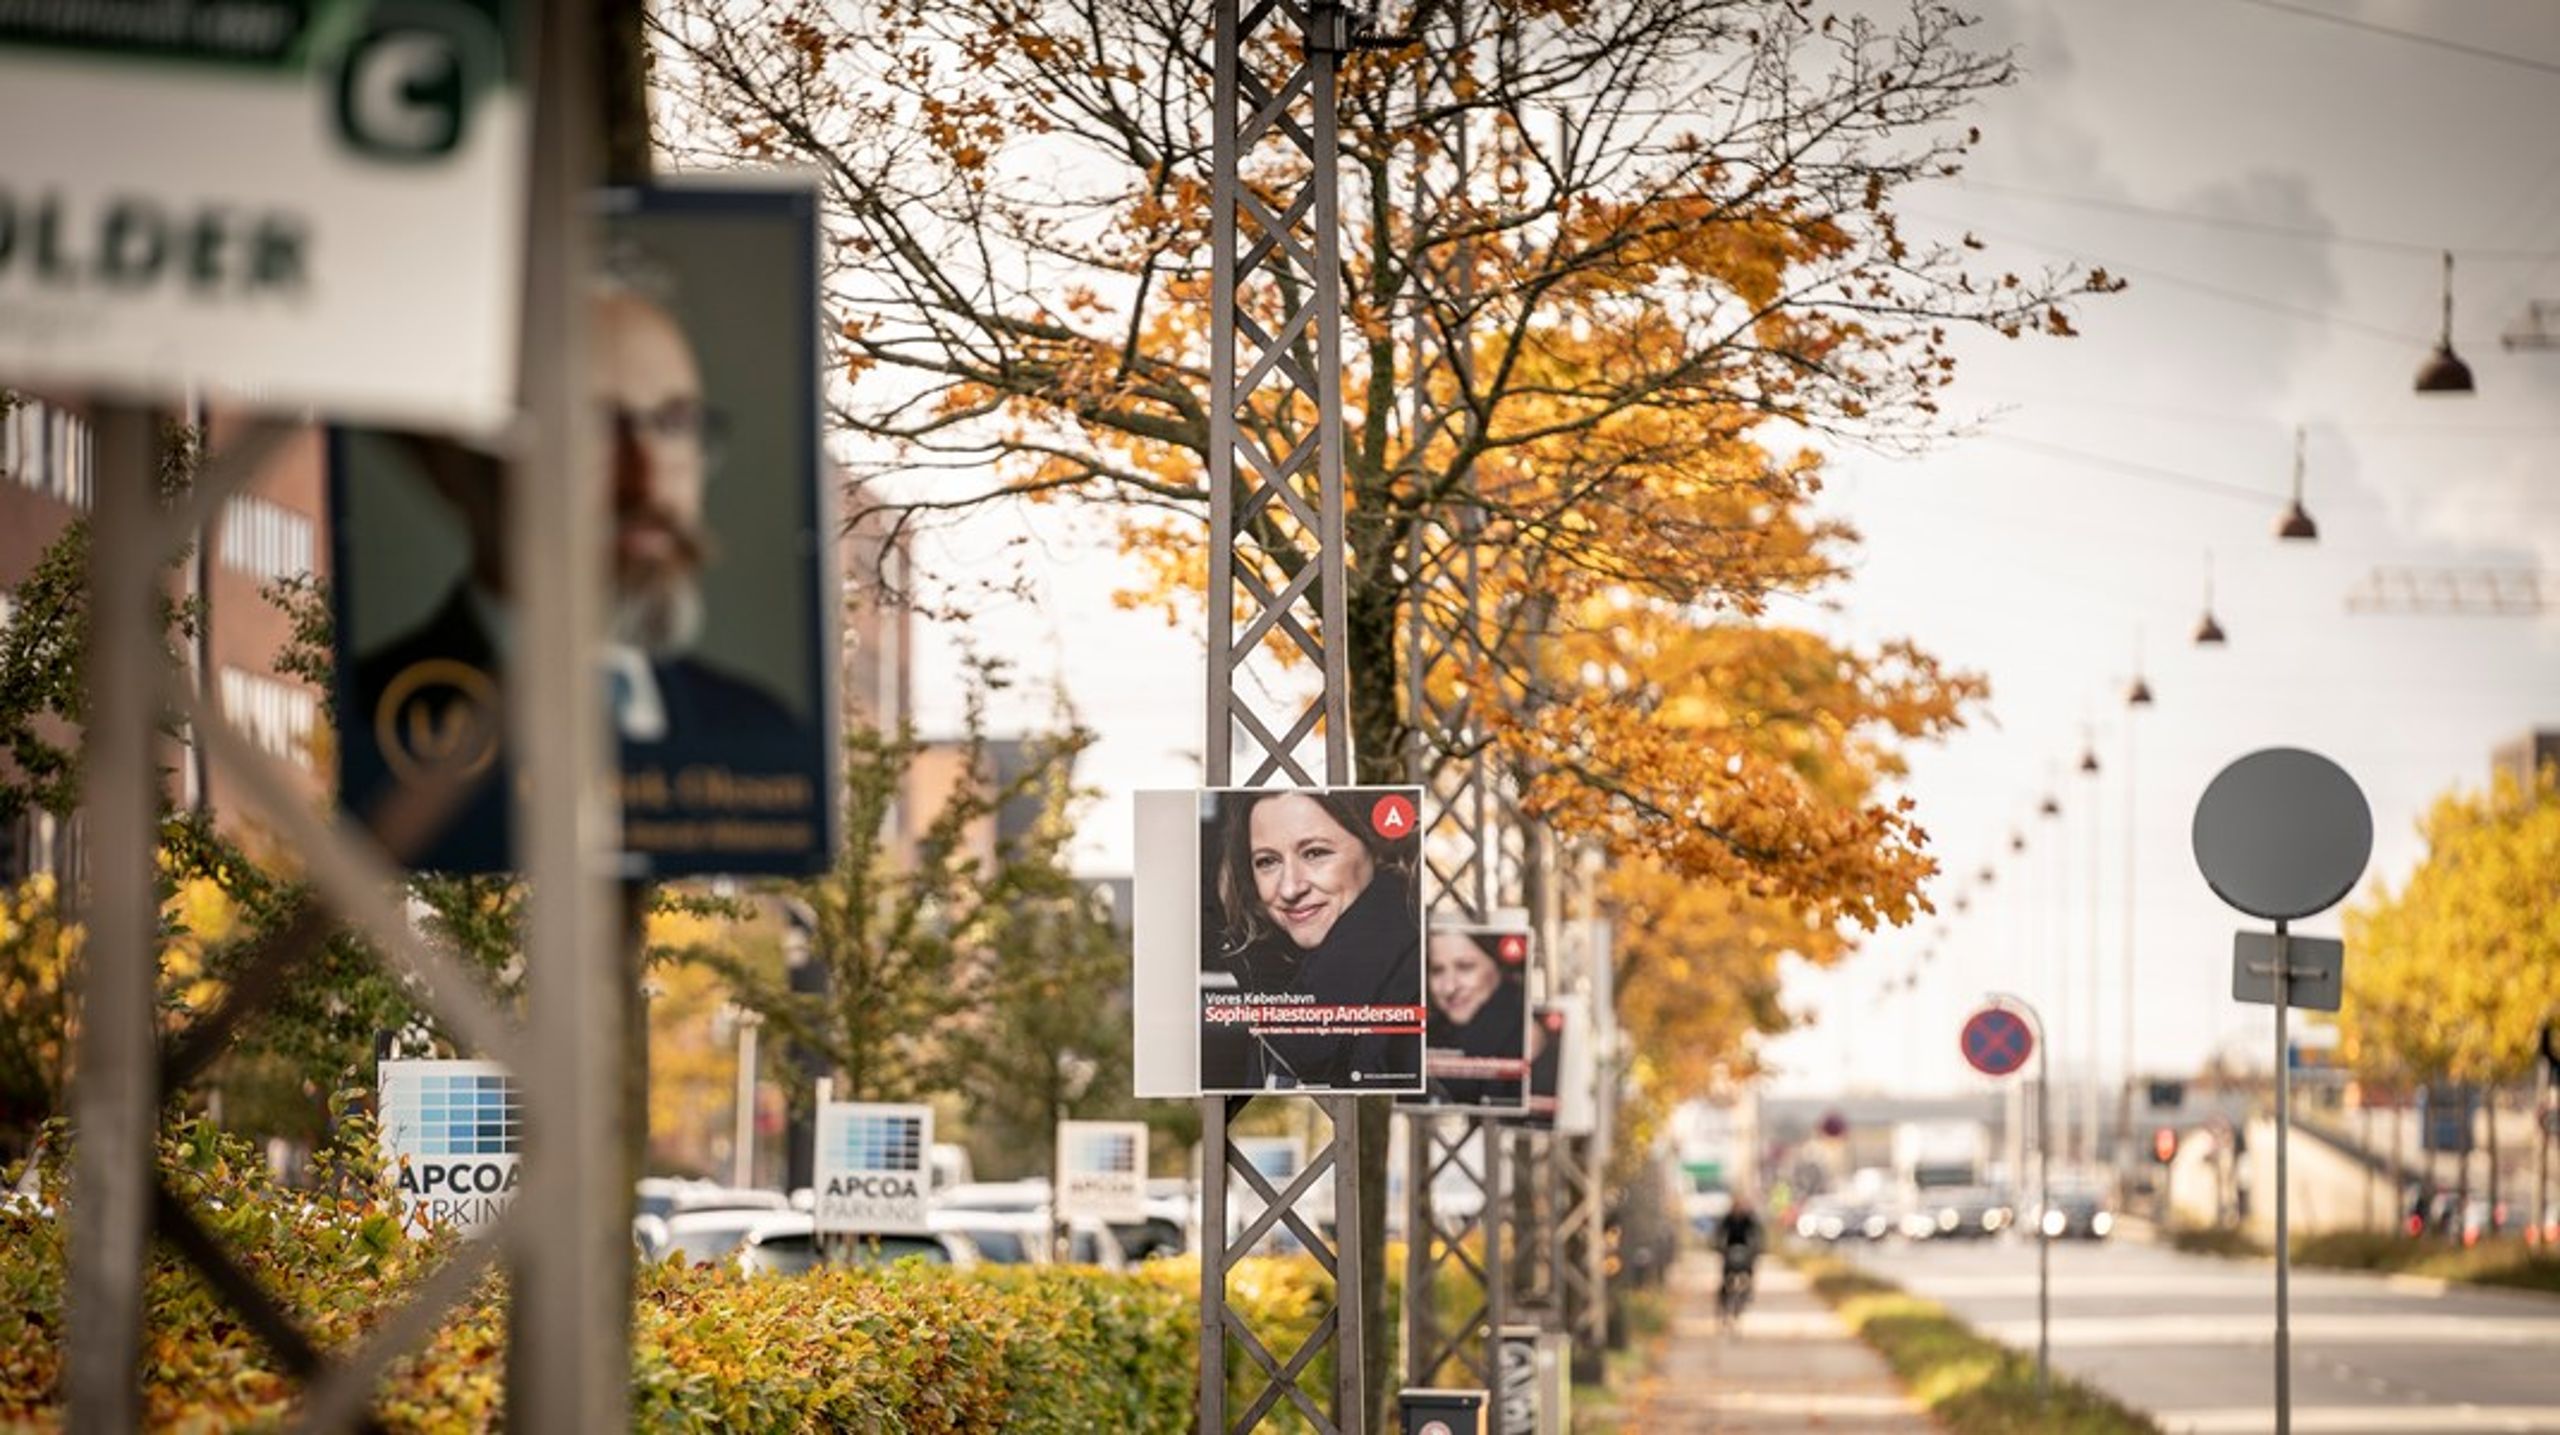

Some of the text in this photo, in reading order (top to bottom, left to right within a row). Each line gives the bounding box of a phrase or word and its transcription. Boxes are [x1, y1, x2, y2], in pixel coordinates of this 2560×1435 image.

[348, 28, 462, 152] C
[1384, 804, 1404, 827] A
[1205, 991, 1316, 1005] Vores København
[1205, 1005, 1415, 1026] Sophie Hæstorp Andersen
[827, 1176, 918, 1198] APCOA
